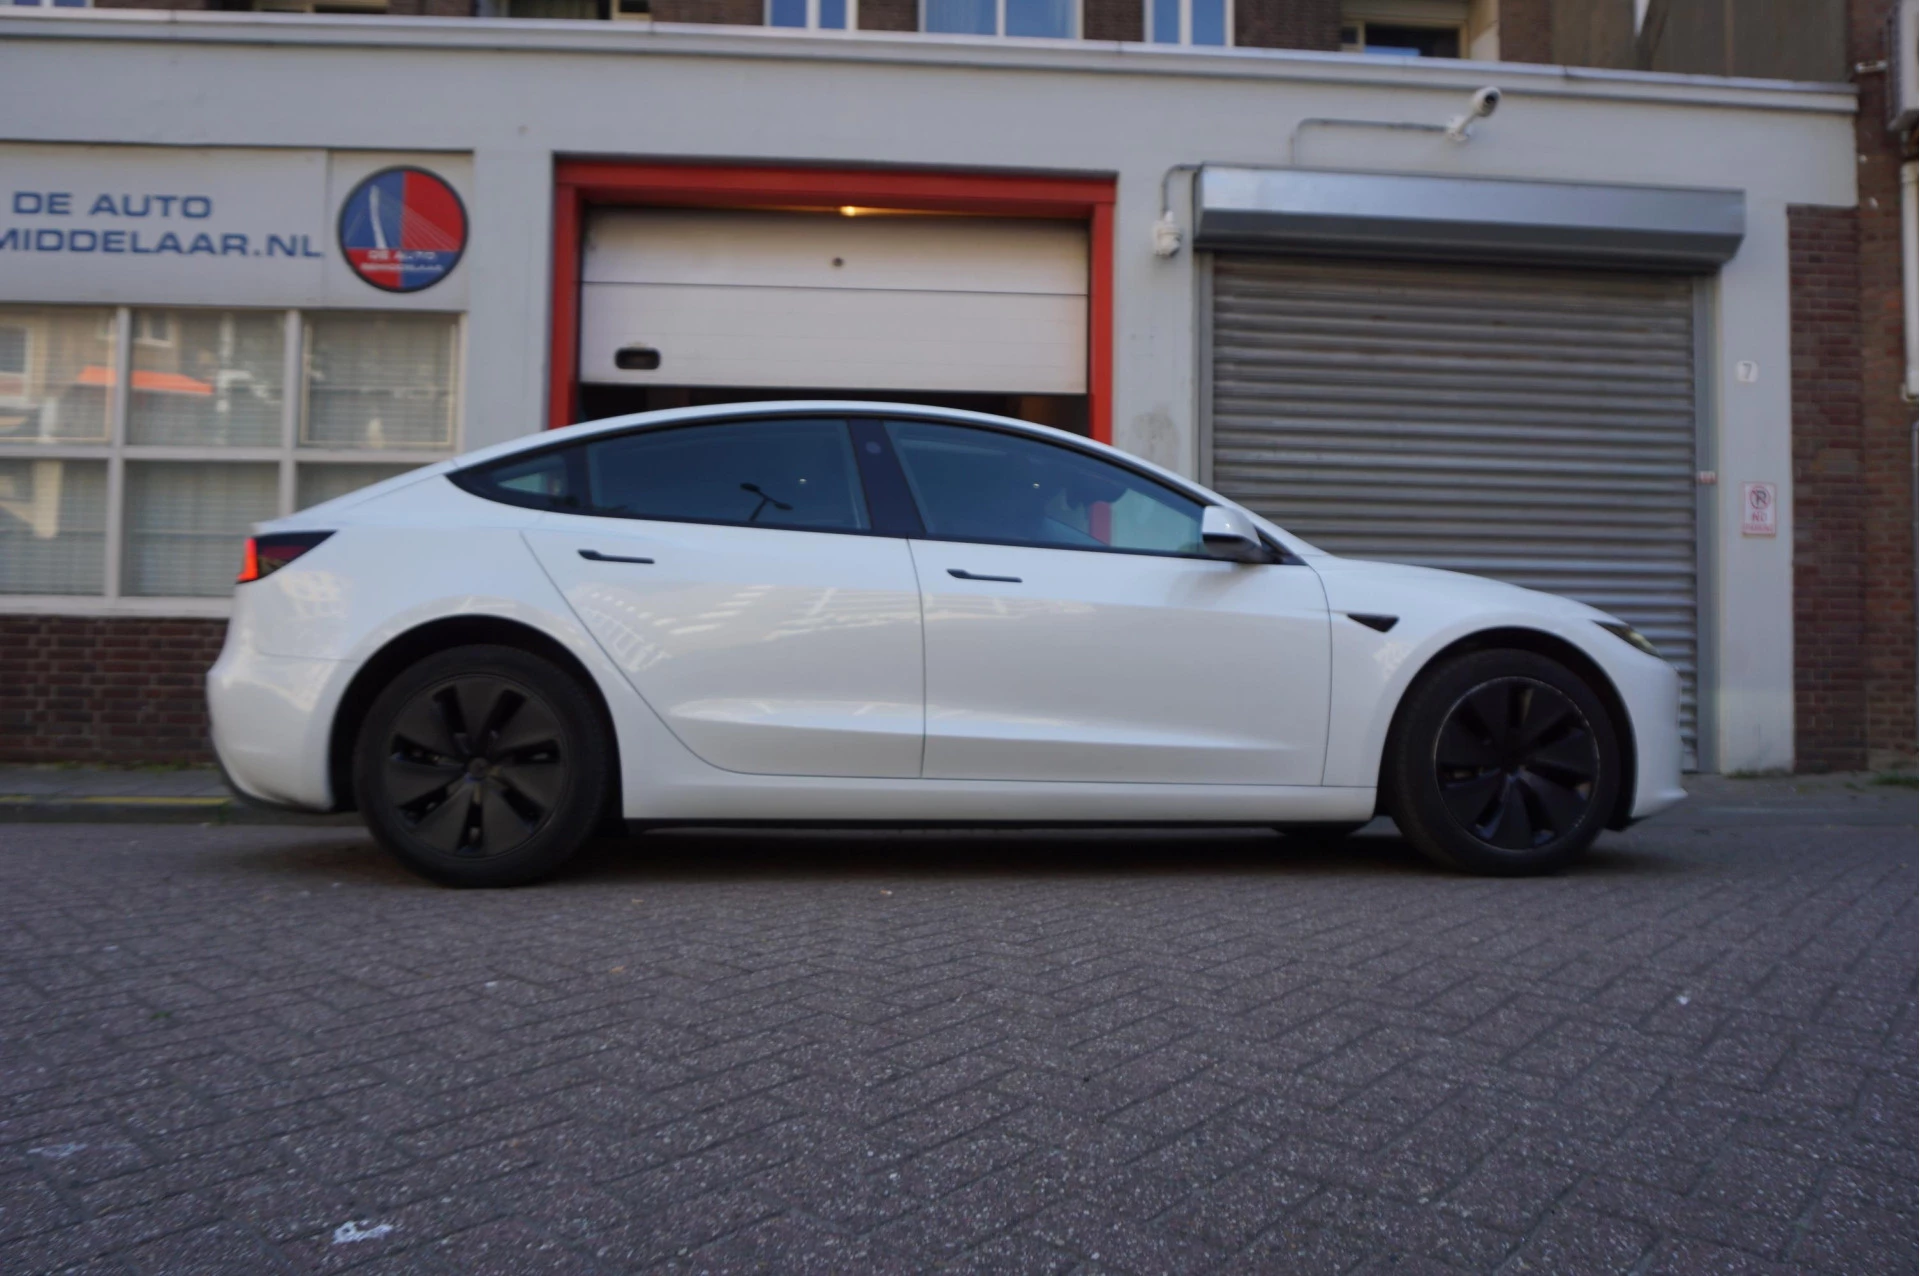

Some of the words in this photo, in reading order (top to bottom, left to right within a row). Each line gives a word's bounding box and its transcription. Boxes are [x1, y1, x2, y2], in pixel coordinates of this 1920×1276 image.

[13, 191, 72, 215] DE
[88, 193, 213, 219] AUTO
[1743, 362, 1752, 380] 7
[1752, 511, 1767, 522] NO
